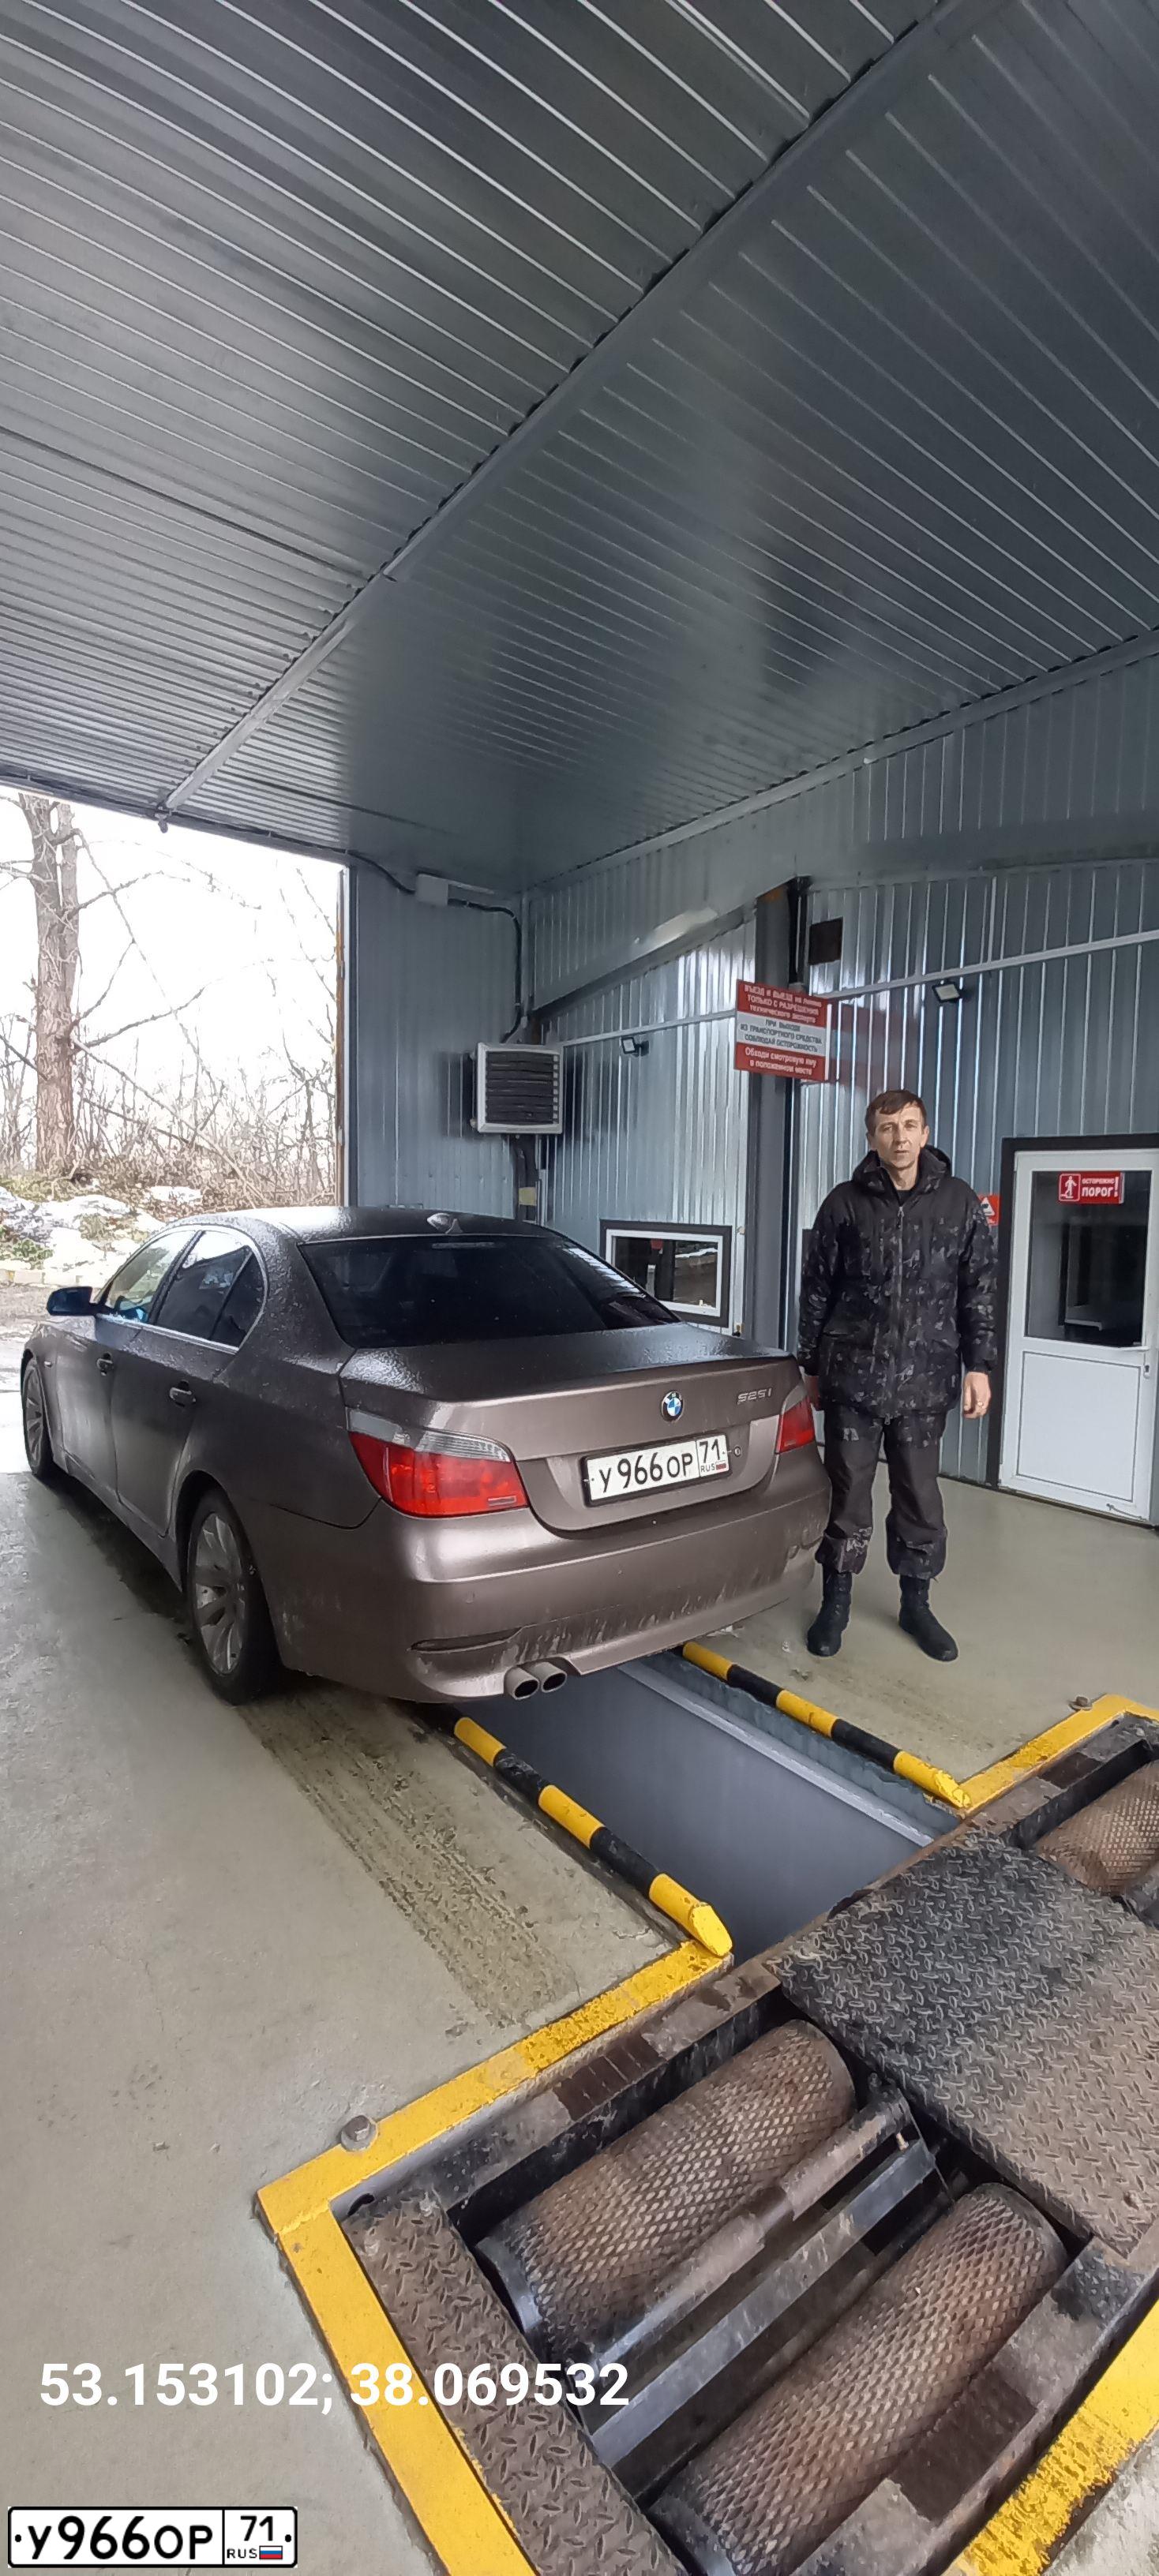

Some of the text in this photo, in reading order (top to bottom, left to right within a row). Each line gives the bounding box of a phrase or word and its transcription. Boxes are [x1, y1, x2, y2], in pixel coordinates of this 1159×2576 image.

[748, 994, 772, 1005] ТОЛЬКО
[779, 1002, 819, 1016] РАЗРЕШЕНИЯ
[745, 1034, 818, 1052] СОБЛЮДАЙ ОСТОРОЖНОСТЬ
[749, 1025, 794, 1039] ТРАНСПОРТНОГО
[796, 1034, 822, 1044] СРЕДСТВА
[745, 1046, 816, 1069] Обходи смотровую яму
[699, 1439, 721, 1464] 71
[700, 1462, 715, 1473] RUS
